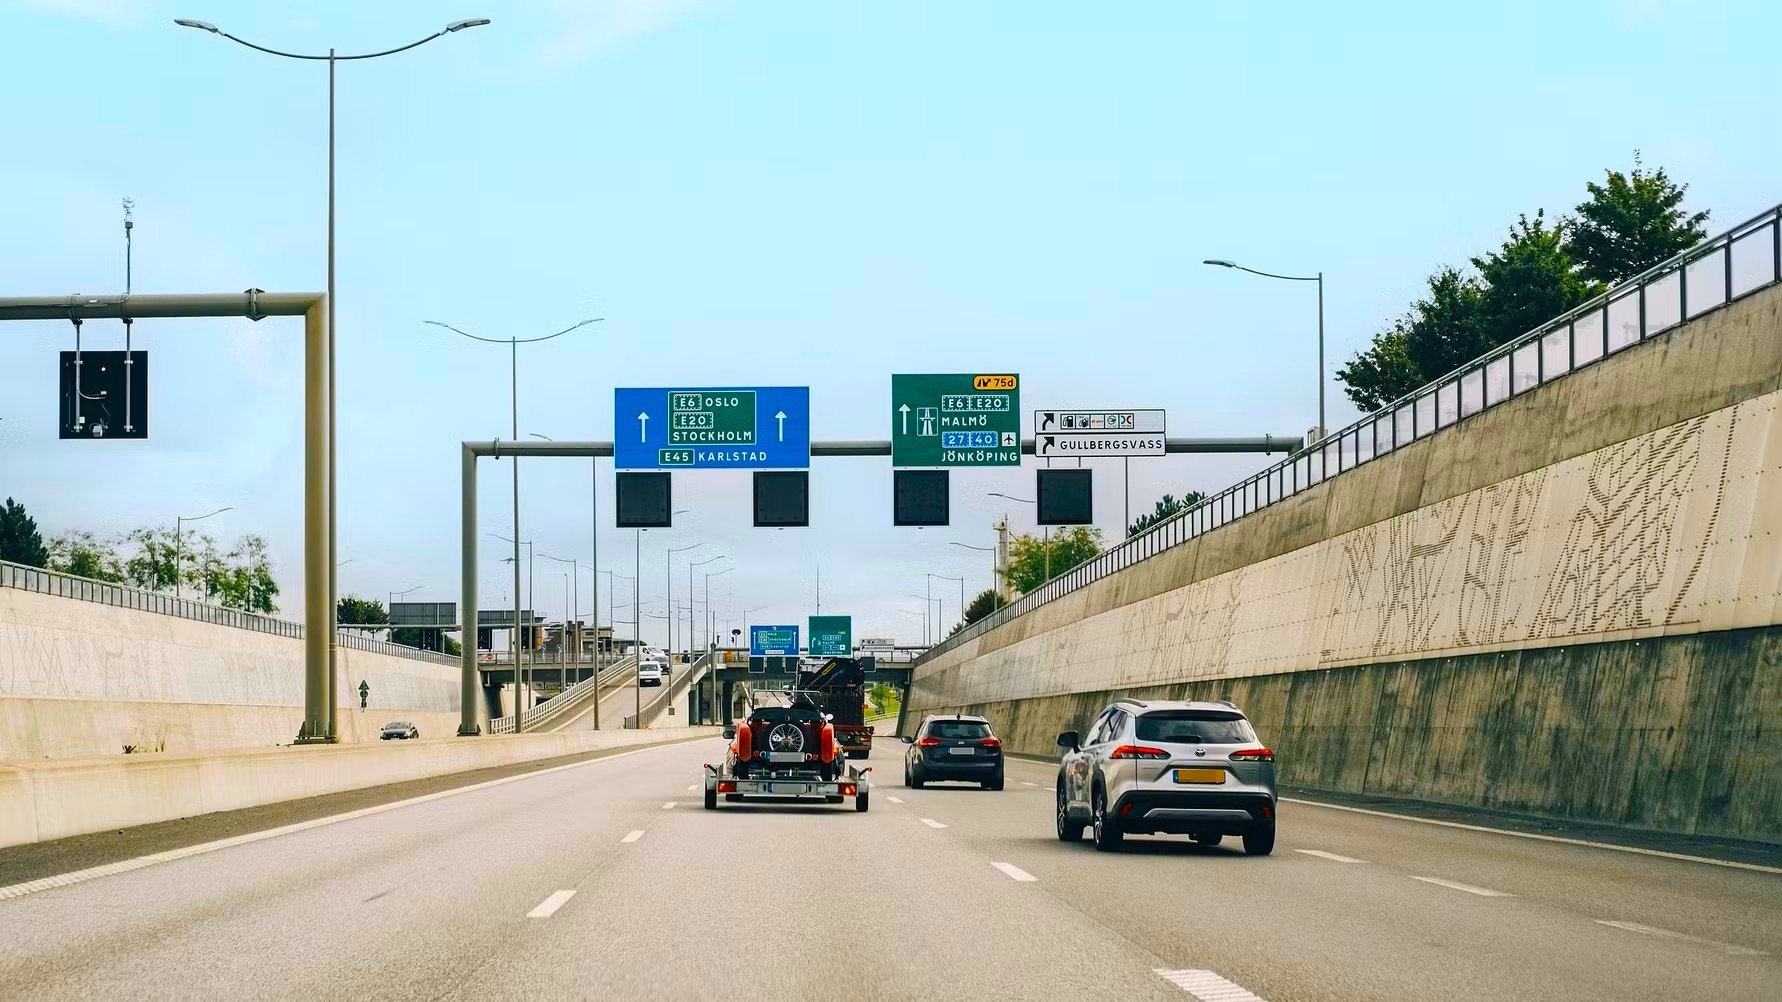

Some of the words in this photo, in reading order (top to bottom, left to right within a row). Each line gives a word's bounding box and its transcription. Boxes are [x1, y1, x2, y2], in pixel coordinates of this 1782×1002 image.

[993, 378, 1014, 387] 75d
[680, 398, 695, 407] E6
[705, 398, 739, 407] OSLO
[948, 399, 963, 408] E6
[976, 399, 1002, 408] E20
[681, 416, 706, 425] E20
[942, 415, 987, 426] MALMÖ
[673, 431, 752, 441] STOCKHOLM
[948, 435, 964, 445] 27
[975, 435, 993, 444] 40
[1060, 440, 1162, 450] GULLBERGSVASS
[665, 453, 689, 462] E45
[698, 452, 767, 461] KARLSTAD
[941, 450, 1018, 462] JÖNKÖPING
